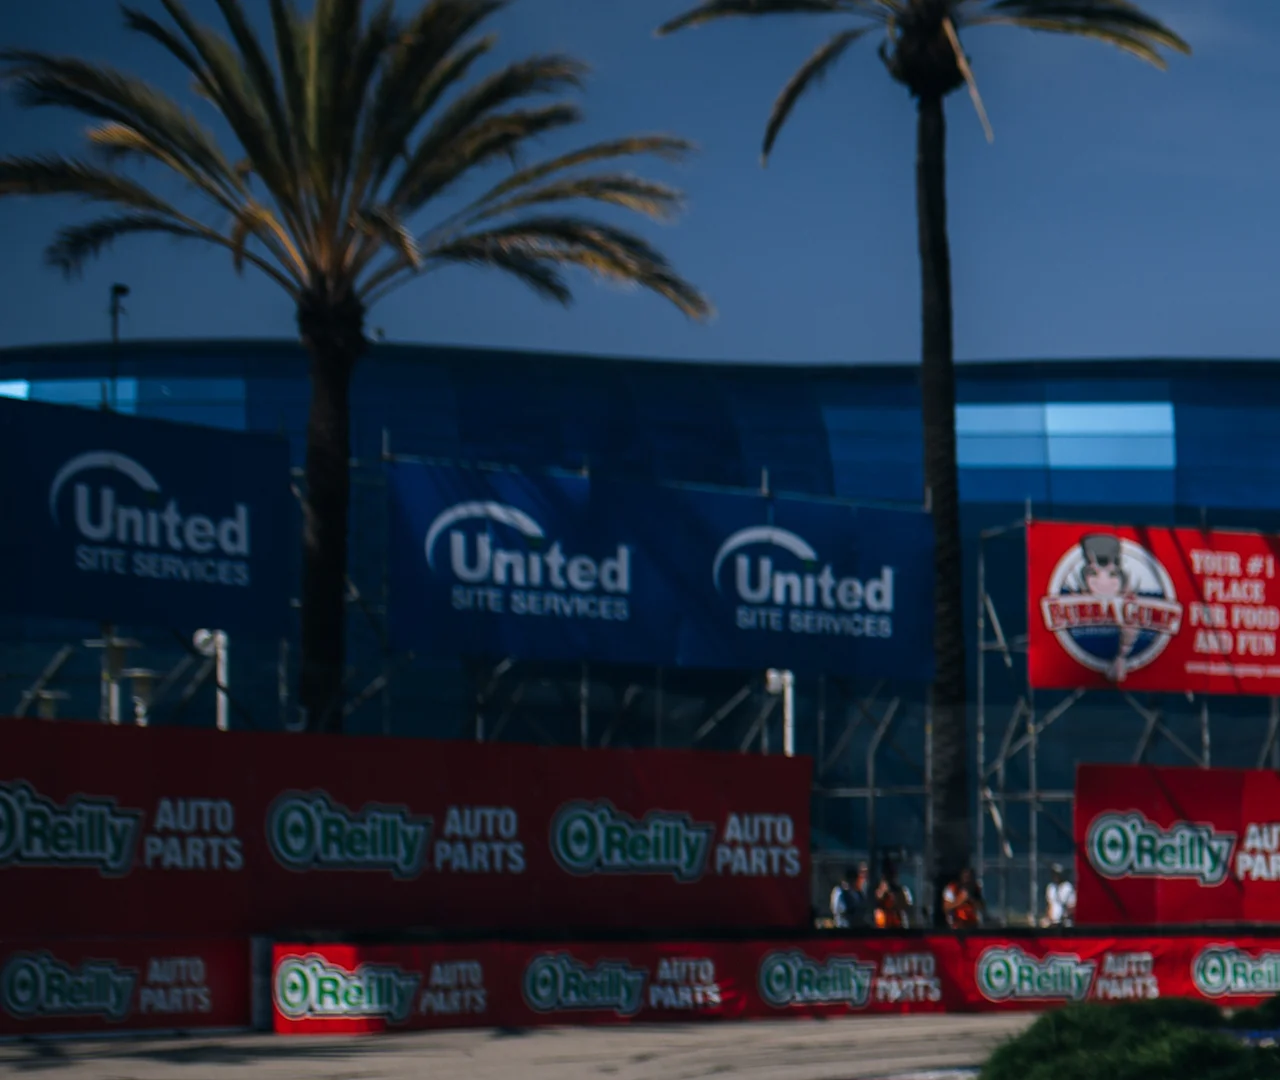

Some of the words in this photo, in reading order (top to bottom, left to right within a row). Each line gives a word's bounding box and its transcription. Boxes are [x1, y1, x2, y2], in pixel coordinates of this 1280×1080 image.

[73, 483, 250, 557] United
[75, 544, 127, 575] SITE
[133, 553, 250, 586] SERVICES
[449, 531, 631, 593] United
[1190, 549, 1241, 577] YOUR
[735, 555, 895, 611] United
[1204, 577, 1265, 604] PLACE
[451, 585, 502, 613] SITE
[510, 589, 631, 621] SERVICES
[1189, 601, 1227, 628] FOR
[1232, 604, 1280, 631] FOOD
[736, 606, 783, 631] SITE
[788, 610, 893, 638] SERVICES
[1193, 629, 1233, 655] AND
[1237, 631, 1277, 657] FUN
[154, 797, 235, 833] AUTO
[444, 806, 518, 838] AUTO
[724, 813, 794, 844] AUTO
[144, 836, 244, 872] PARTS
[434, 840, 526, 874] PARTS
[716, 846, 801, 877] PARTS
[147, 957, 205, 984] AUTO
[429, 960, 483, 986] AUTO
[657, 958, 715, 983] AUTO
[882, 953, 936, 977] AUTO
[1103, 950, 1153, 977] AUTO
[140, 986, 211, 1014] PARTS
[420, 988, 488, 1016] PARTS
[649, 984, 722, 1010] PARTS
[876, 976, 942, 1003] PARTS
[1096, 976, 1159, 1000] PARTS
